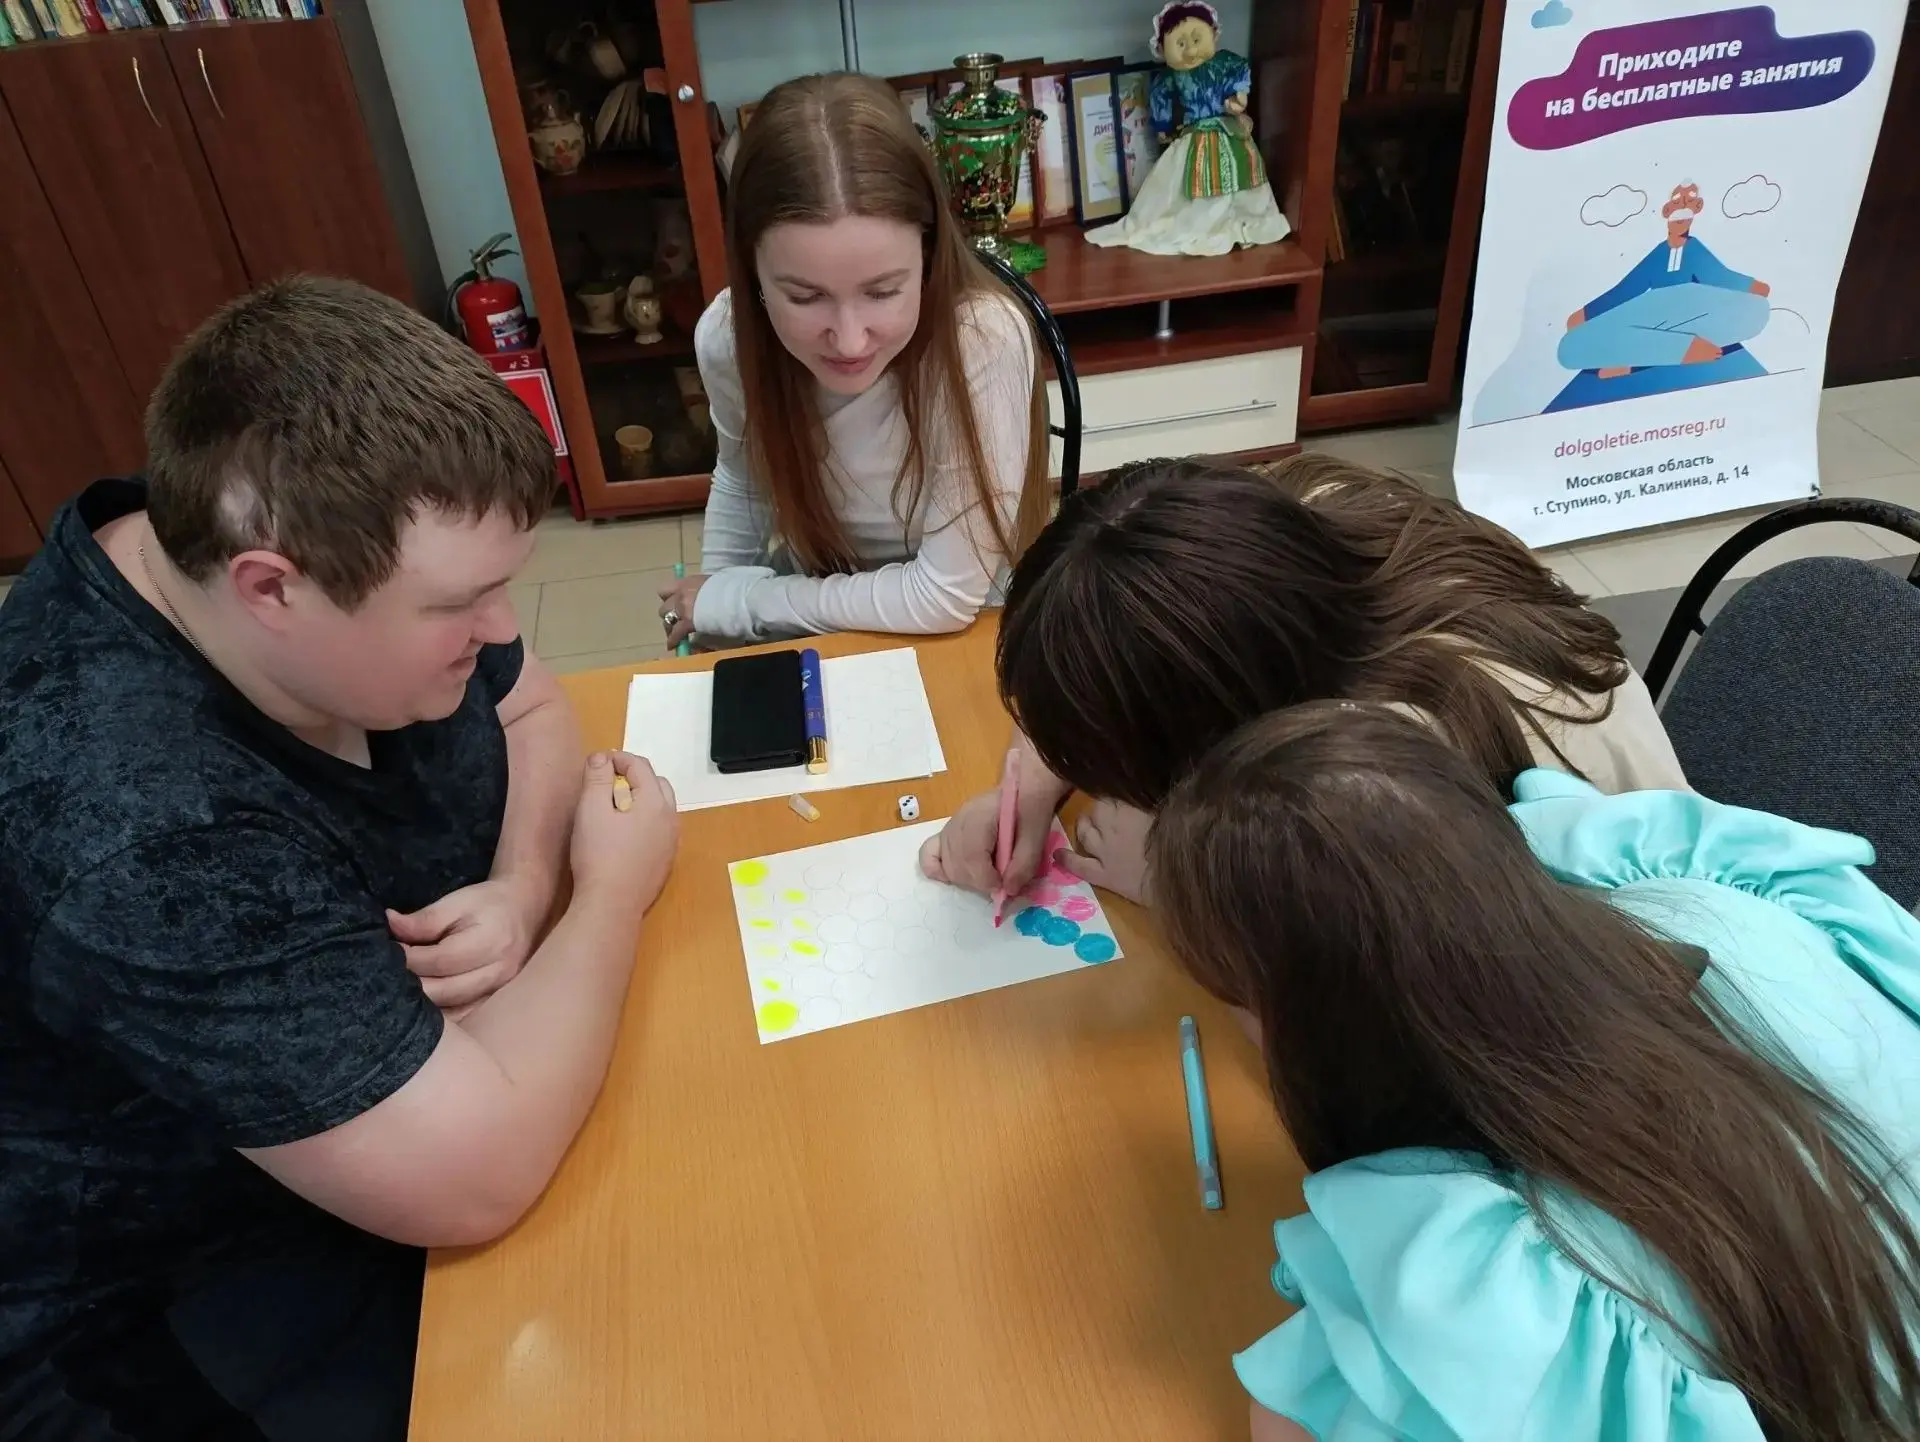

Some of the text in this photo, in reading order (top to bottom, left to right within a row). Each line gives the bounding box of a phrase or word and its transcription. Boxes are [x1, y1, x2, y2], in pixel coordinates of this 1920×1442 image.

[1598, 39, 1743, 81] Приходите
[1545, 56, 1844, 118] на бесплатные занятия
[1553, 417, 1727, 458] dolgoletie.mosreg.ru
[1533, 465, 1750, 516] г. Ступино, ул. Калинина, д. 14
[1565, 455, 1714, 490] Московская область
